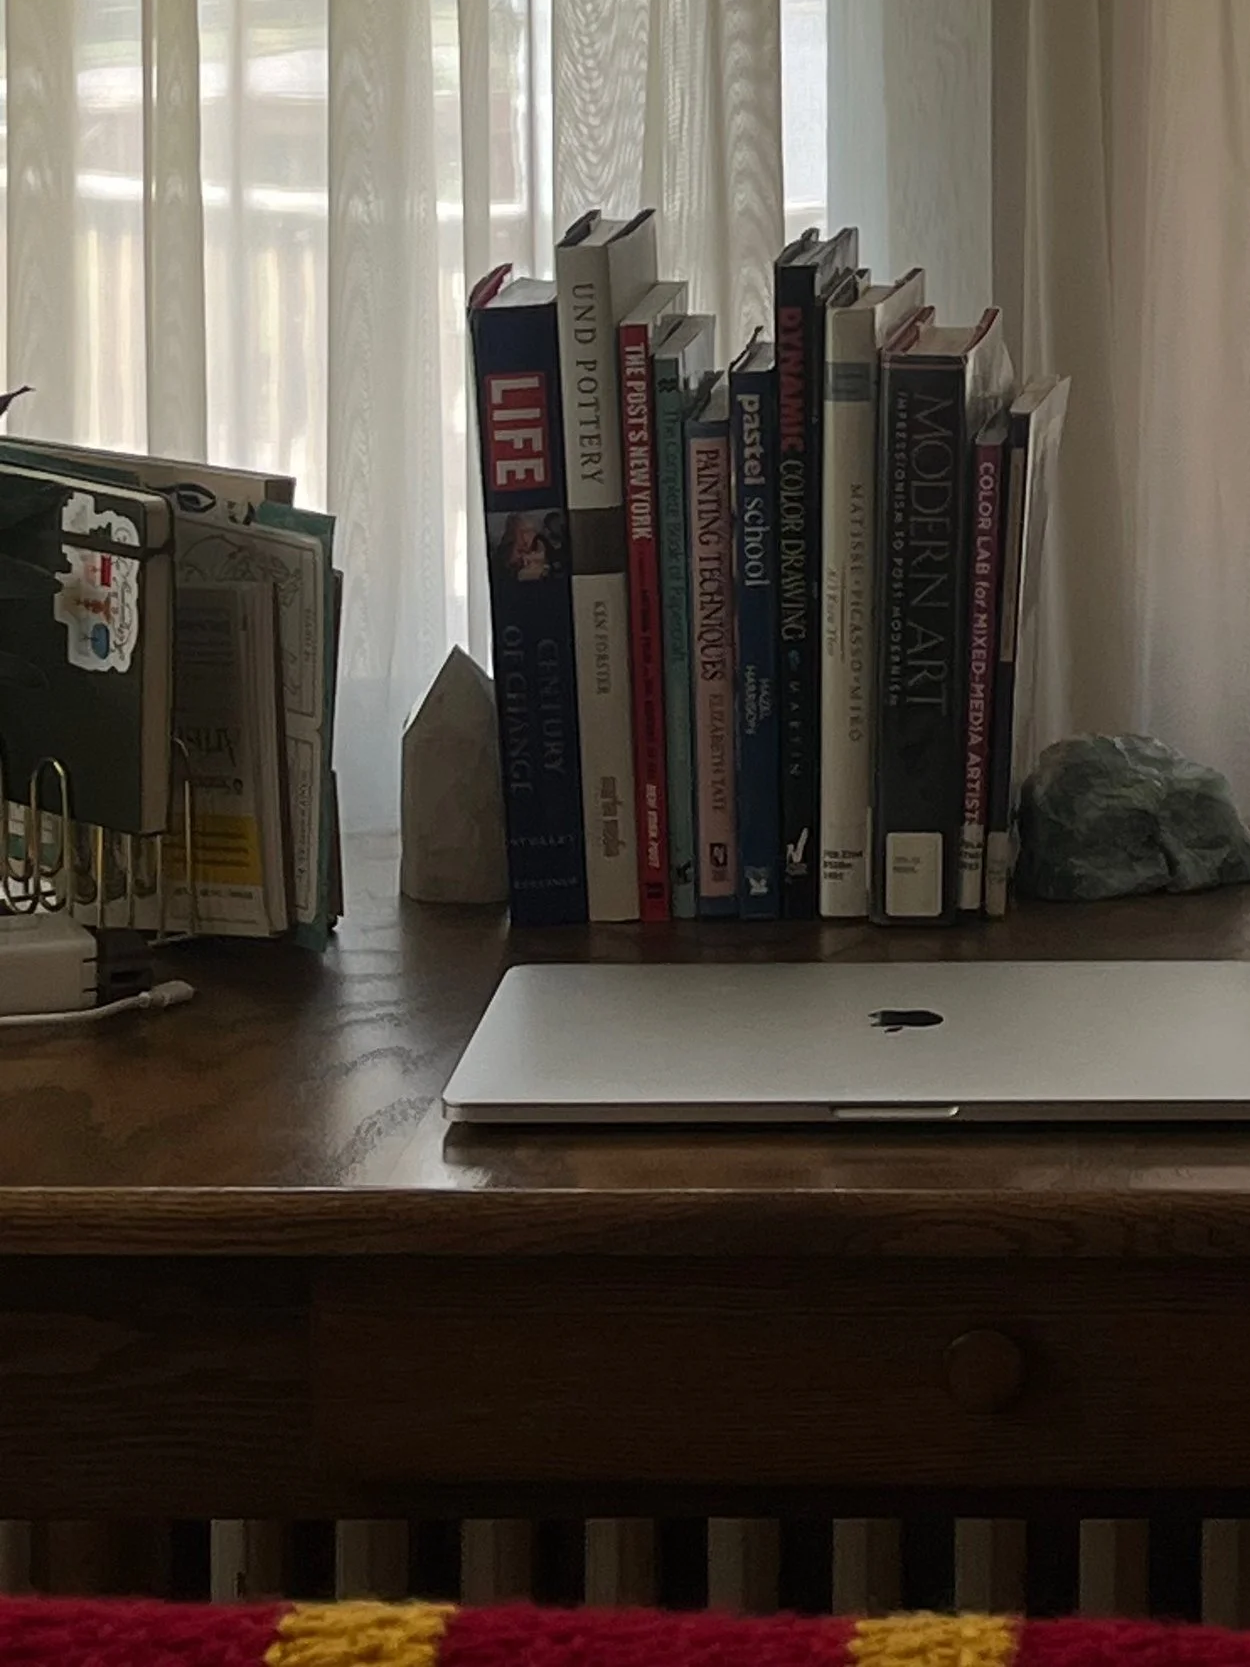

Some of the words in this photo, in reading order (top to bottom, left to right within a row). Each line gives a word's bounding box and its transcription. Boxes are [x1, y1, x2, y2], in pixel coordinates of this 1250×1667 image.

[572, 283, 596, 344] UND
[624, 344, 645, 376] THE
[780, 306, 804, 454] DYNAMIC
[491, 376, 544, 487] LIFE
[576, 360, 604, 485] POTTERY
[627, 380, 649, 442] POST'S
[737, 394, 765, 485] pastel
[894, 390, 907, 523] IMPRESSIONISM
[628, 446, 649, 487] NEW
[696, 450, 722, 545] PAINTING
[780, 460, 805, 533] COLOR
[909, 392, 953, 608] MODERN
[978, 462, 995, 529] COLOR
[631, 493, 652, 540] YORK
[744, 496, 770, 586] school
[975, 537, 992, 575] LAB
[593, 601, 608, 630] KEN
[698, 556, 726, 681] TECHNIQUES
[780, 538, 807, 642] DRAWING
[974, 582, 989, 609] for
[502, 625, 522, 662] OF
[906, 622, 947, 717] ART
[968, 613, 987, 745] MIXED-MEDIA
[506, 672, 533, 796] CHANGE
[537, 638, 565, 775] CENTURY
